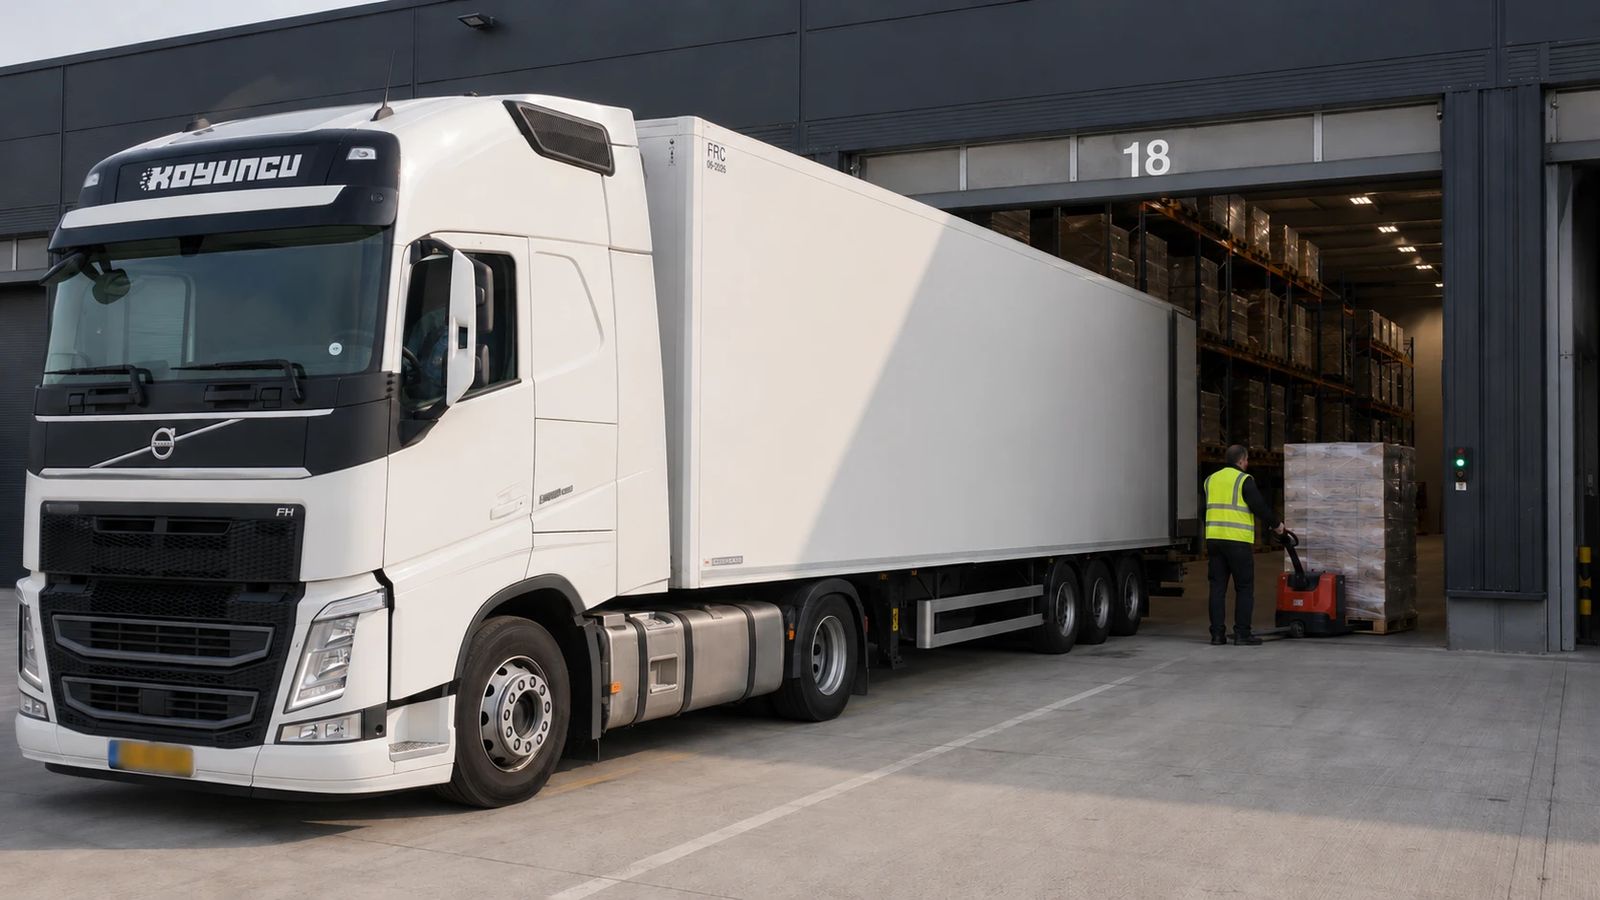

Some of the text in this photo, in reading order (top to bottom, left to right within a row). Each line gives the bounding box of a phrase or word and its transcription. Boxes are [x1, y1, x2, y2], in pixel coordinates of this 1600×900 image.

[707, 142, 726, 162] FRC
[1123, 139, 1170, 177] 18
[147, 154, 303, 191] KOYUNCU
[276, 507, 294, 517] FH
